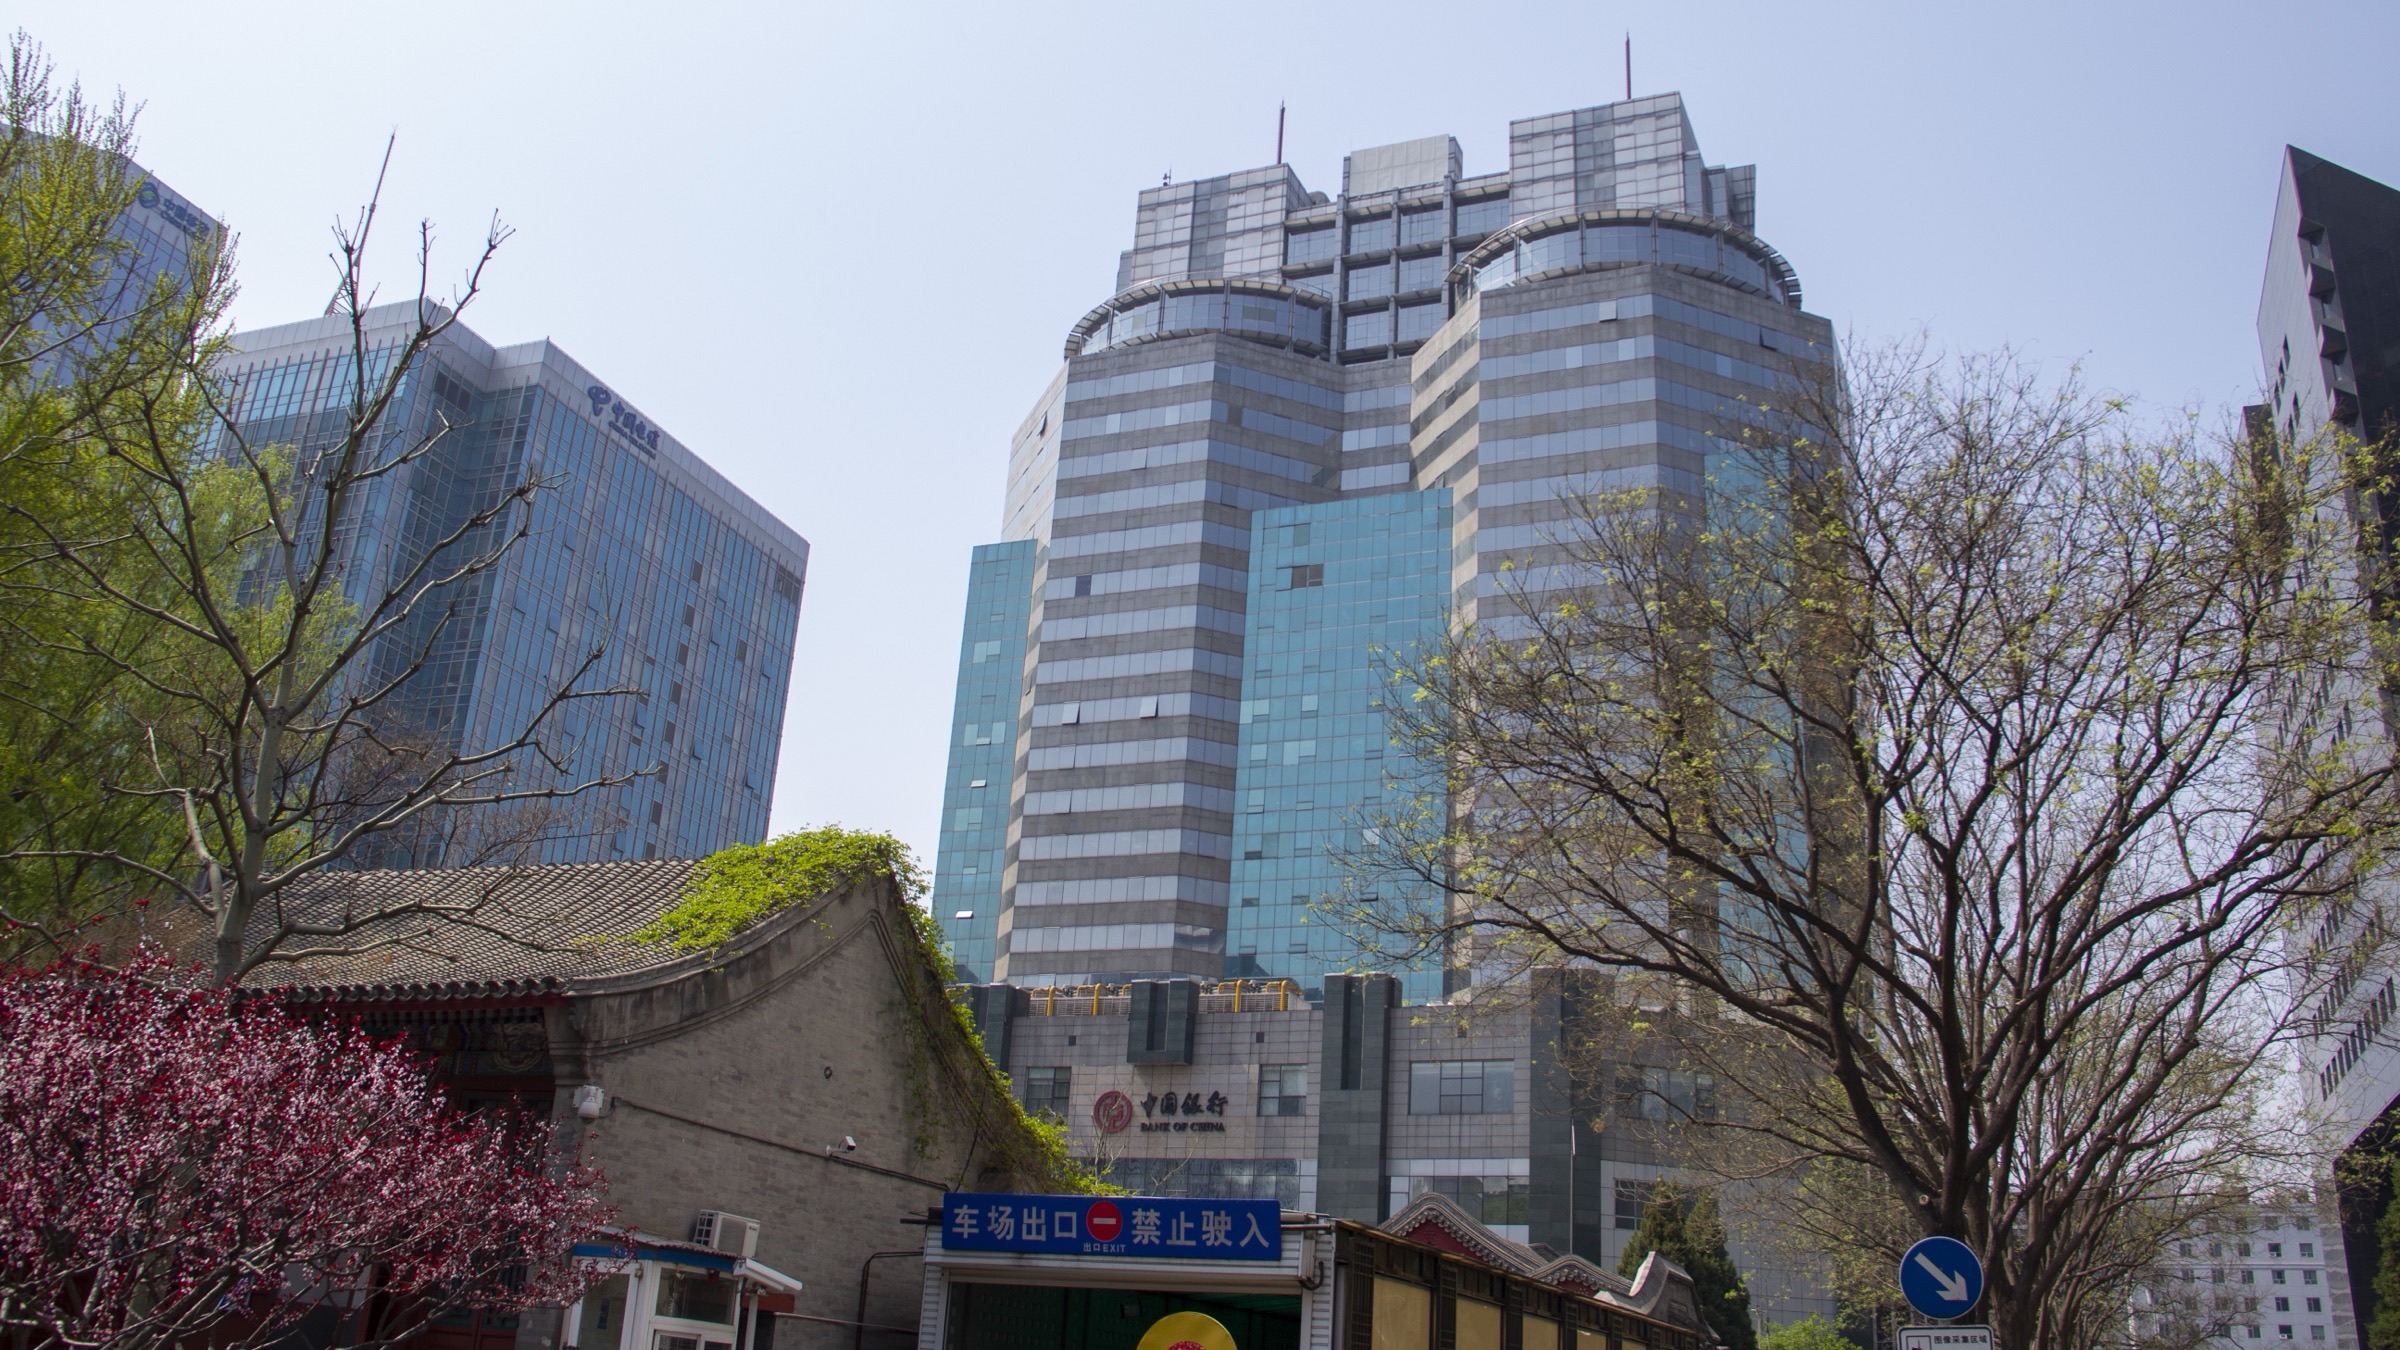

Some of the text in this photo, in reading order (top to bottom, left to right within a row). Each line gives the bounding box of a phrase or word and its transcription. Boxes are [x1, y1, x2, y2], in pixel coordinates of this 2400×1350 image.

[612, 401, 660, 451] 中国电信
[1140, 1090, 1228, 1118] 中国银行
[1140, 1122, 1225, 1132] BANK OF CHINA
[951, 1204, 1270, 1249] 车场出口 禁止驶入
[1083, 1242, 1126, 1253] 出口 EXIT
[1934, 1335, 1988, 1344] 图像采集区域
